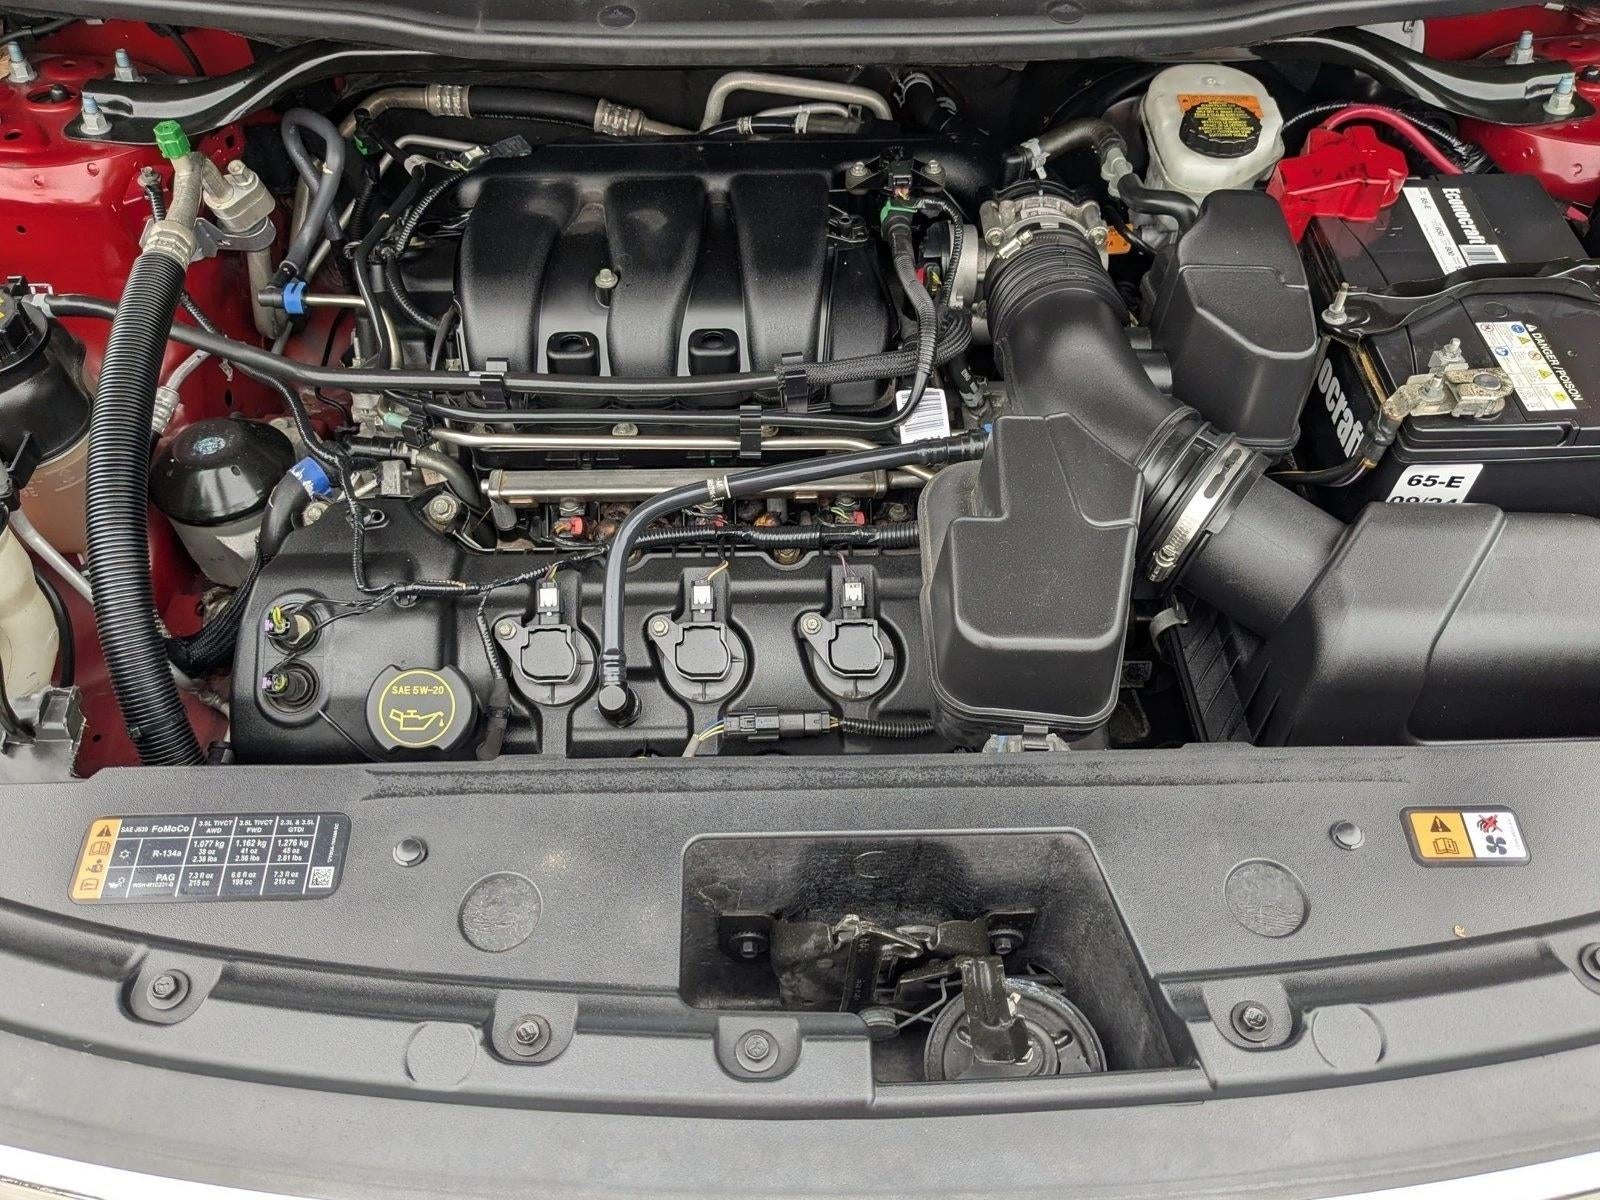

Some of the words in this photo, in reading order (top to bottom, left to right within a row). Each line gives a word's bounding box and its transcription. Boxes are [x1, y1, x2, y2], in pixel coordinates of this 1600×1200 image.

[1441, 188, 1486, 244] Econocraft
[1531, 332, 1560, 366] DANGER
[1556, 370, 1584, 401] POISON
[1407, 474, 1465, 488] 65-E
[392, 685, 411, 695] SAE
[412, 685, 445, 695] 5W-20
[151, 824, 190, 833] FoMoCo
[193, 840, 214, 848] 1.077
[215, 840, 225, 849] kg
[235, 839, 256, 847] 1.162
[257, 839, 267, 849] kg
[277, 839, 298, 847] 1.276
[299, 839, 309, 848] kg
[152, 850, 182, 858] R-134a
[155, 873, 176, 881] PAG
